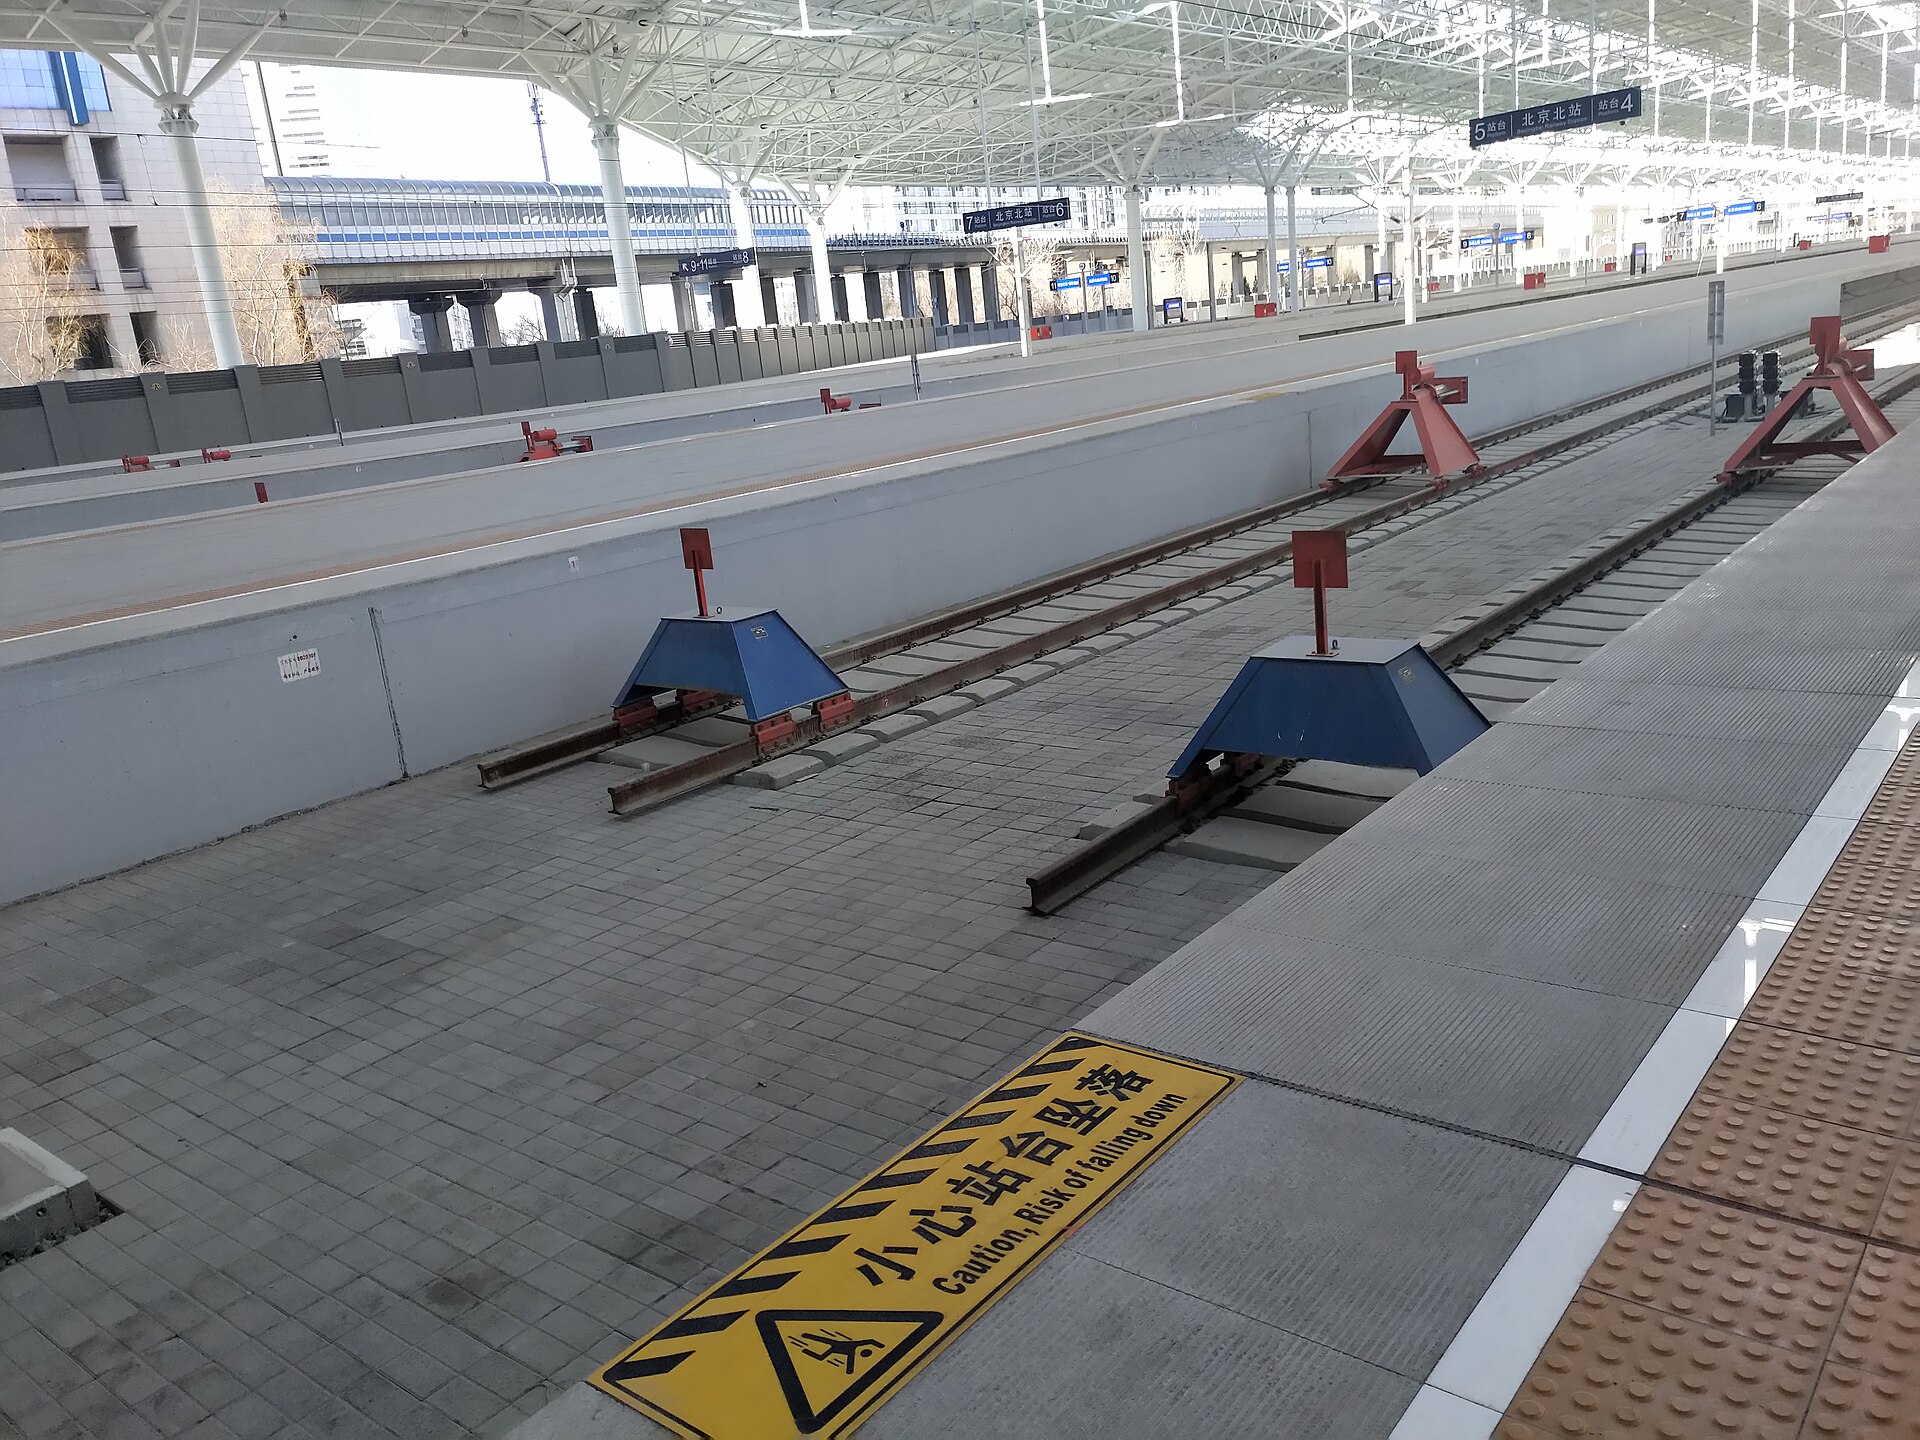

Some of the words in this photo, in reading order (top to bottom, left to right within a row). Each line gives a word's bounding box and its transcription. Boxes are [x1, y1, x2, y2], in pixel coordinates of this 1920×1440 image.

[1597, 98, 1619, 110] 站台
[1620, 93, 1634, 113] 4
[1521, 103, 1583, 127] 北京北站
[1474, 122, 1486, 141] 5
[1486, 120, 1507, 132] 站台
[995, 207, 1033, 222] 北京北站
[1042, 204, 1055, 214] 站台
[1056, 202, 1065, 217] 6
[966, 216, 974, 230] 7
[974, 215, 987, 224] 站台
[742, 250, 749, 264] 8
[853, 1063, 1154, 1287] 小心站台坠落
[932, 1226, 1041, 1295] Caution,
[1013, 1186, 1076, 1225] Risk
[1063, 1167, 1095, 1190] of
[1081, 1127, 1154, 1174] falling
[1131, 1092, 1188, 1128] down
